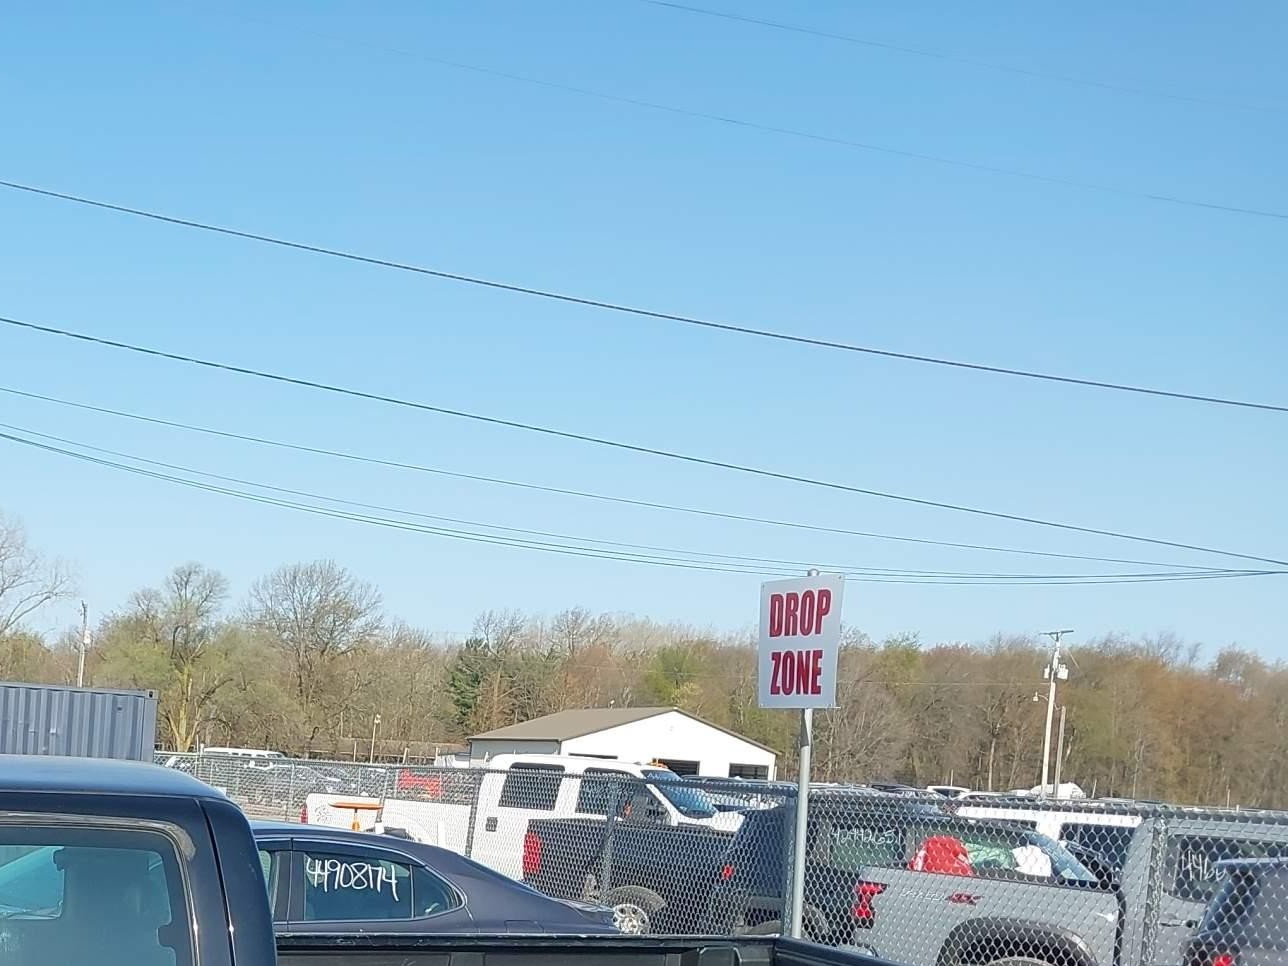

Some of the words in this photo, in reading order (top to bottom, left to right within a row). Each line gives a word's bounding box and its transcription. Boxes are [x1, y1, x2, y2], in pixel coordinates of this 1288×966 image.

[769, 588, 832, 637] DROP
[770, 649, 824, 696] ZONE
[306, 857, 400, 902] 44908174
